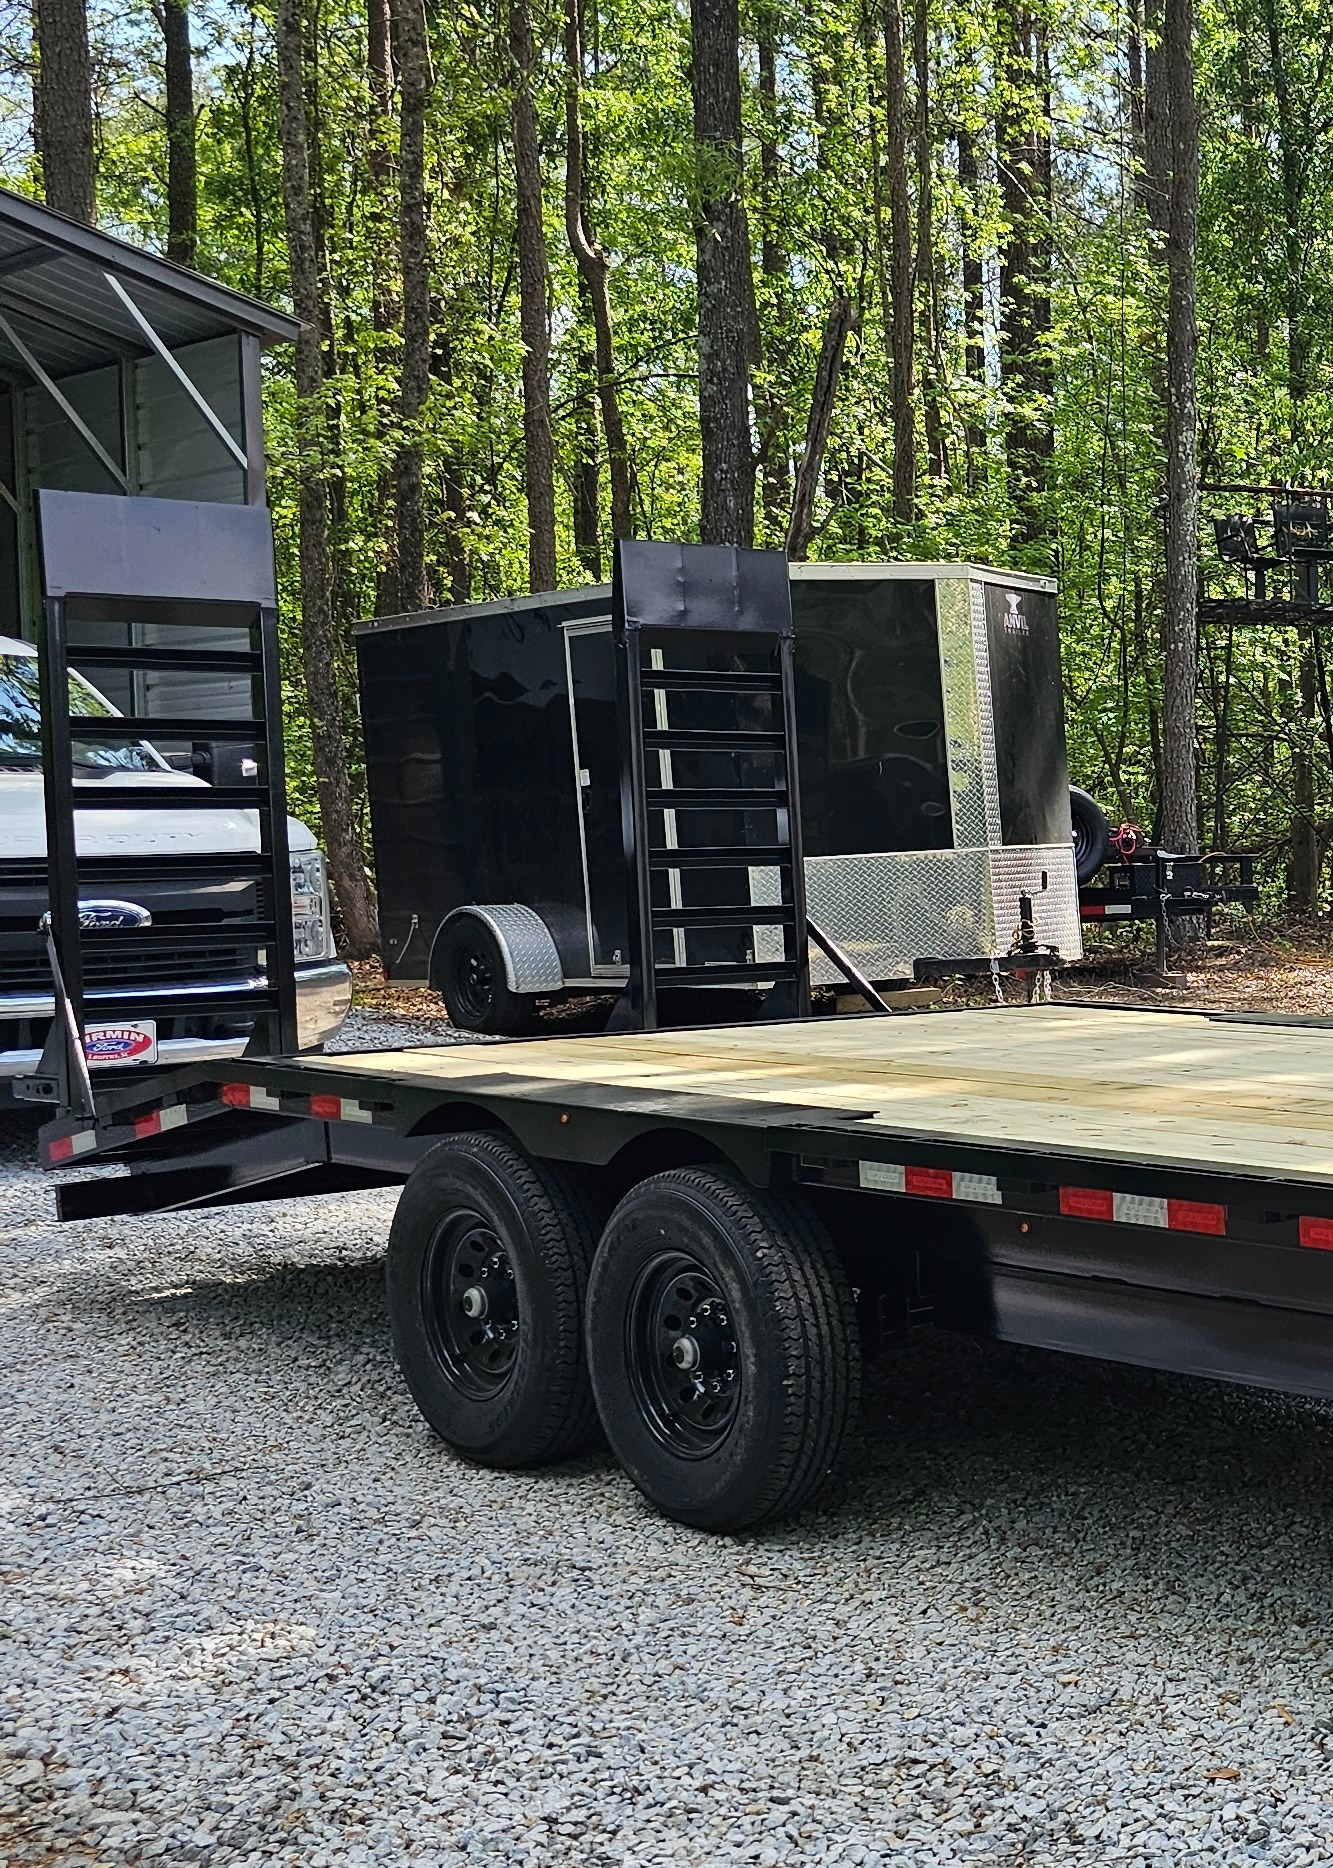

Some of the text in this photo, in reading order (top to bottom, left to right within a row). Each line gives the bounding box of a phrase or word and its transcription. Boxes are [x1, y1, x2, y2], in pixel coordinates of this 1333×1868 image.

[1004, 612, 1029, 630] ANVIL
[78, 911, 124, 927] Ford
[85, 1030, 145, 1043] IRMIN
[93, 1041, 125, 1051] Ford
